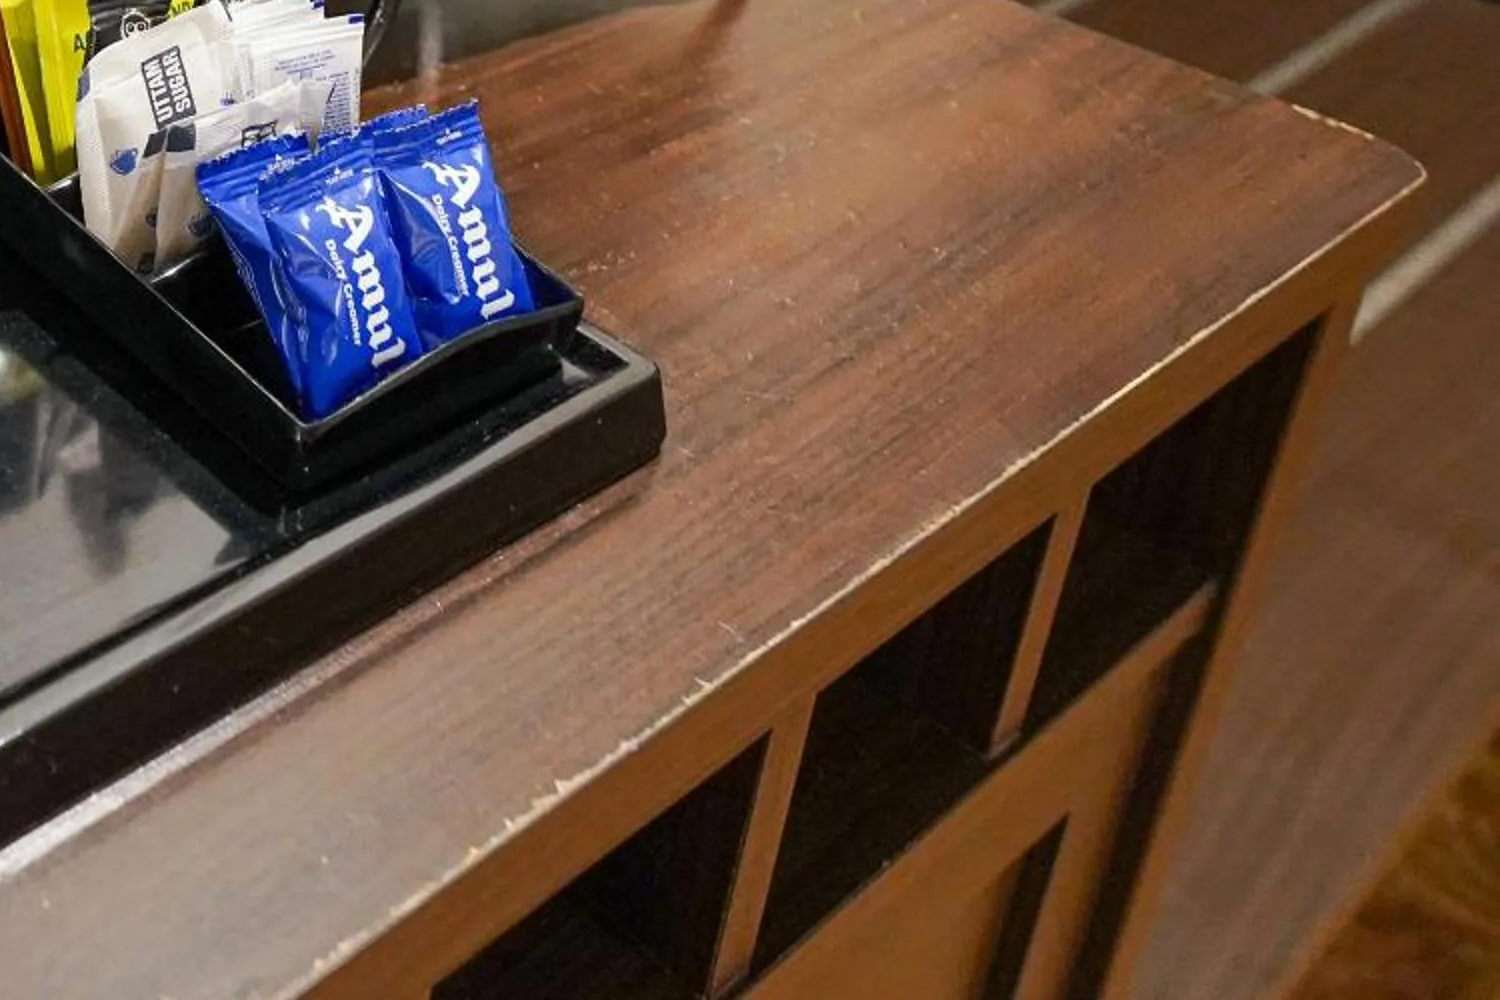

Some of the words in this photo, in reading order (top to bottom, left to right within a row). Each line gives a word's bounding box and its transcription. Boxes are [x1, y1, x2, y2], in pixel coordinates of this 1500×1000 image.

[143, 60, 173, 122] UTTAM
[162, 51, 191, 112] SUGAR
[325, 239, 347, 280] Dairy
[421, 160, 515, 320] Amul
[316, 196, 406, 368] Amul
